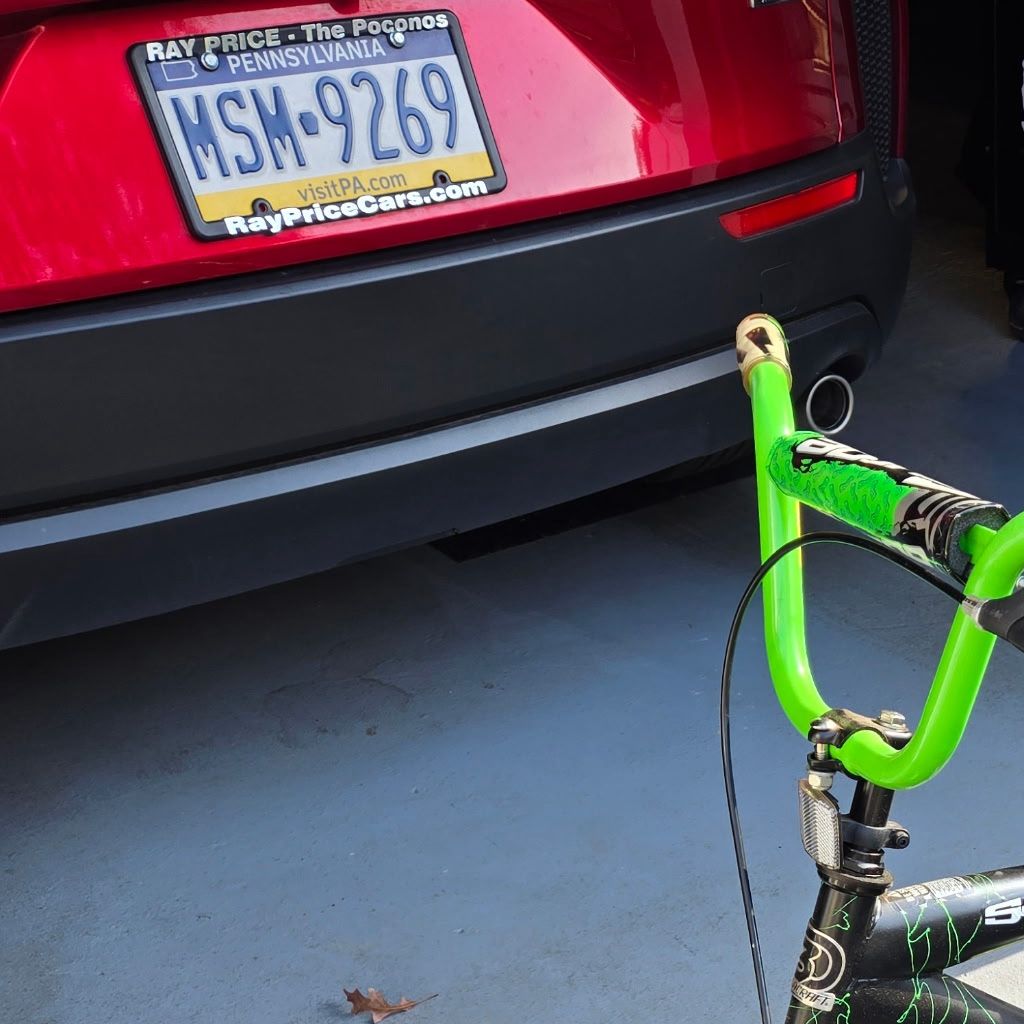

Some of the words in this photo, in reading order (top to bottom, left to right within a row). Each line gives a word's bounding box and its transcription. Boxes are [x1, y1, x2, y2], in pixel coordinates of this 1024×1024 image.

[146, 38, 196, 62] RAY
[204, 27, 281, 53] PRICE
[301, 22, 350, 43] The
[352, 13, 449, 36] Poconos
[228, 40, 386, 75] PENNSYLVANIA
[223, 179, 488, 237] RayPriceCars.com
[297, 172, 407, 203] visitPA.com
